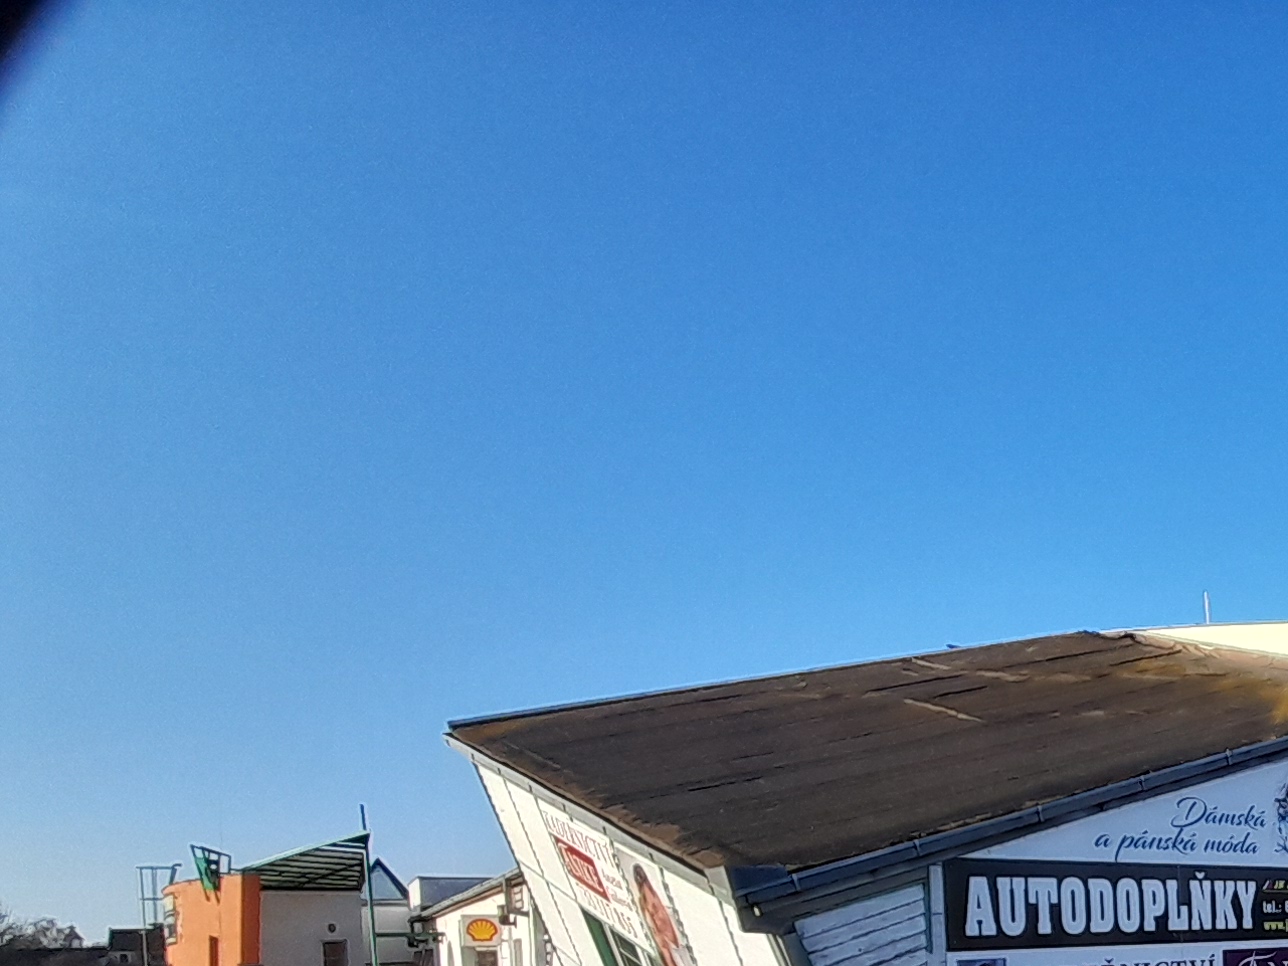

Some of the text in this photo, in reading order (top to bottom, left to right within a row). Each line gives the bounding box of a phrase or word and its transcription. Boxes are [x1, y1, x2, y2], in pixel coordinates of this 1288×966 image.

[1171, 797, 1266, 831] Dámská
[1094, 827, 1258, 862] a pánská móda
[965, 871, 1256, 936] AUTODOPLŇKY
[1263, 901, 1282, 913] tel.:
